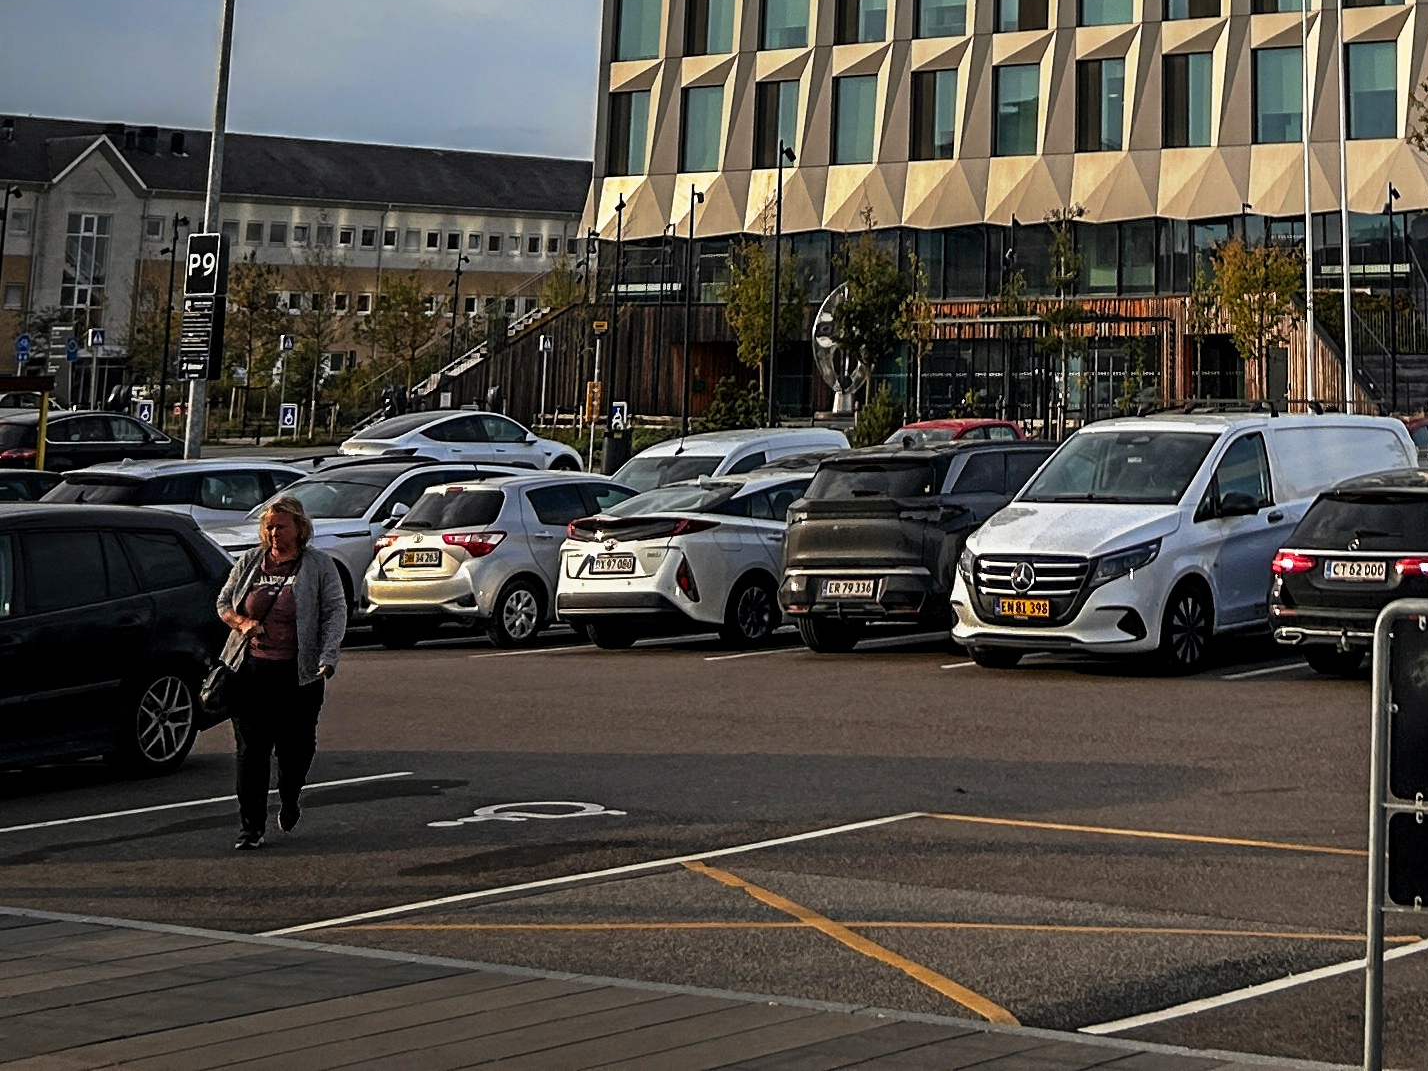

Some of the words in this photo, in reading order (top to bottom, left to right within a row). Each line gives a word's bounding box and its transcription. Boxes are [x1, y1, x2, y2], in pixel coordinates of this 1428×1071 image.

[188, 252, 215, 276] P9
[1332, 562, 1348, 576] CT
[1349, 562, 1362, 576] 62
[1364, 562, 1385, 577] 000
[828, 582, 841, 594] ER
[842, 582, 854, 594] 79
[854, 582, 872, 594] 336
[1029, 601, 1048, 615] 398
